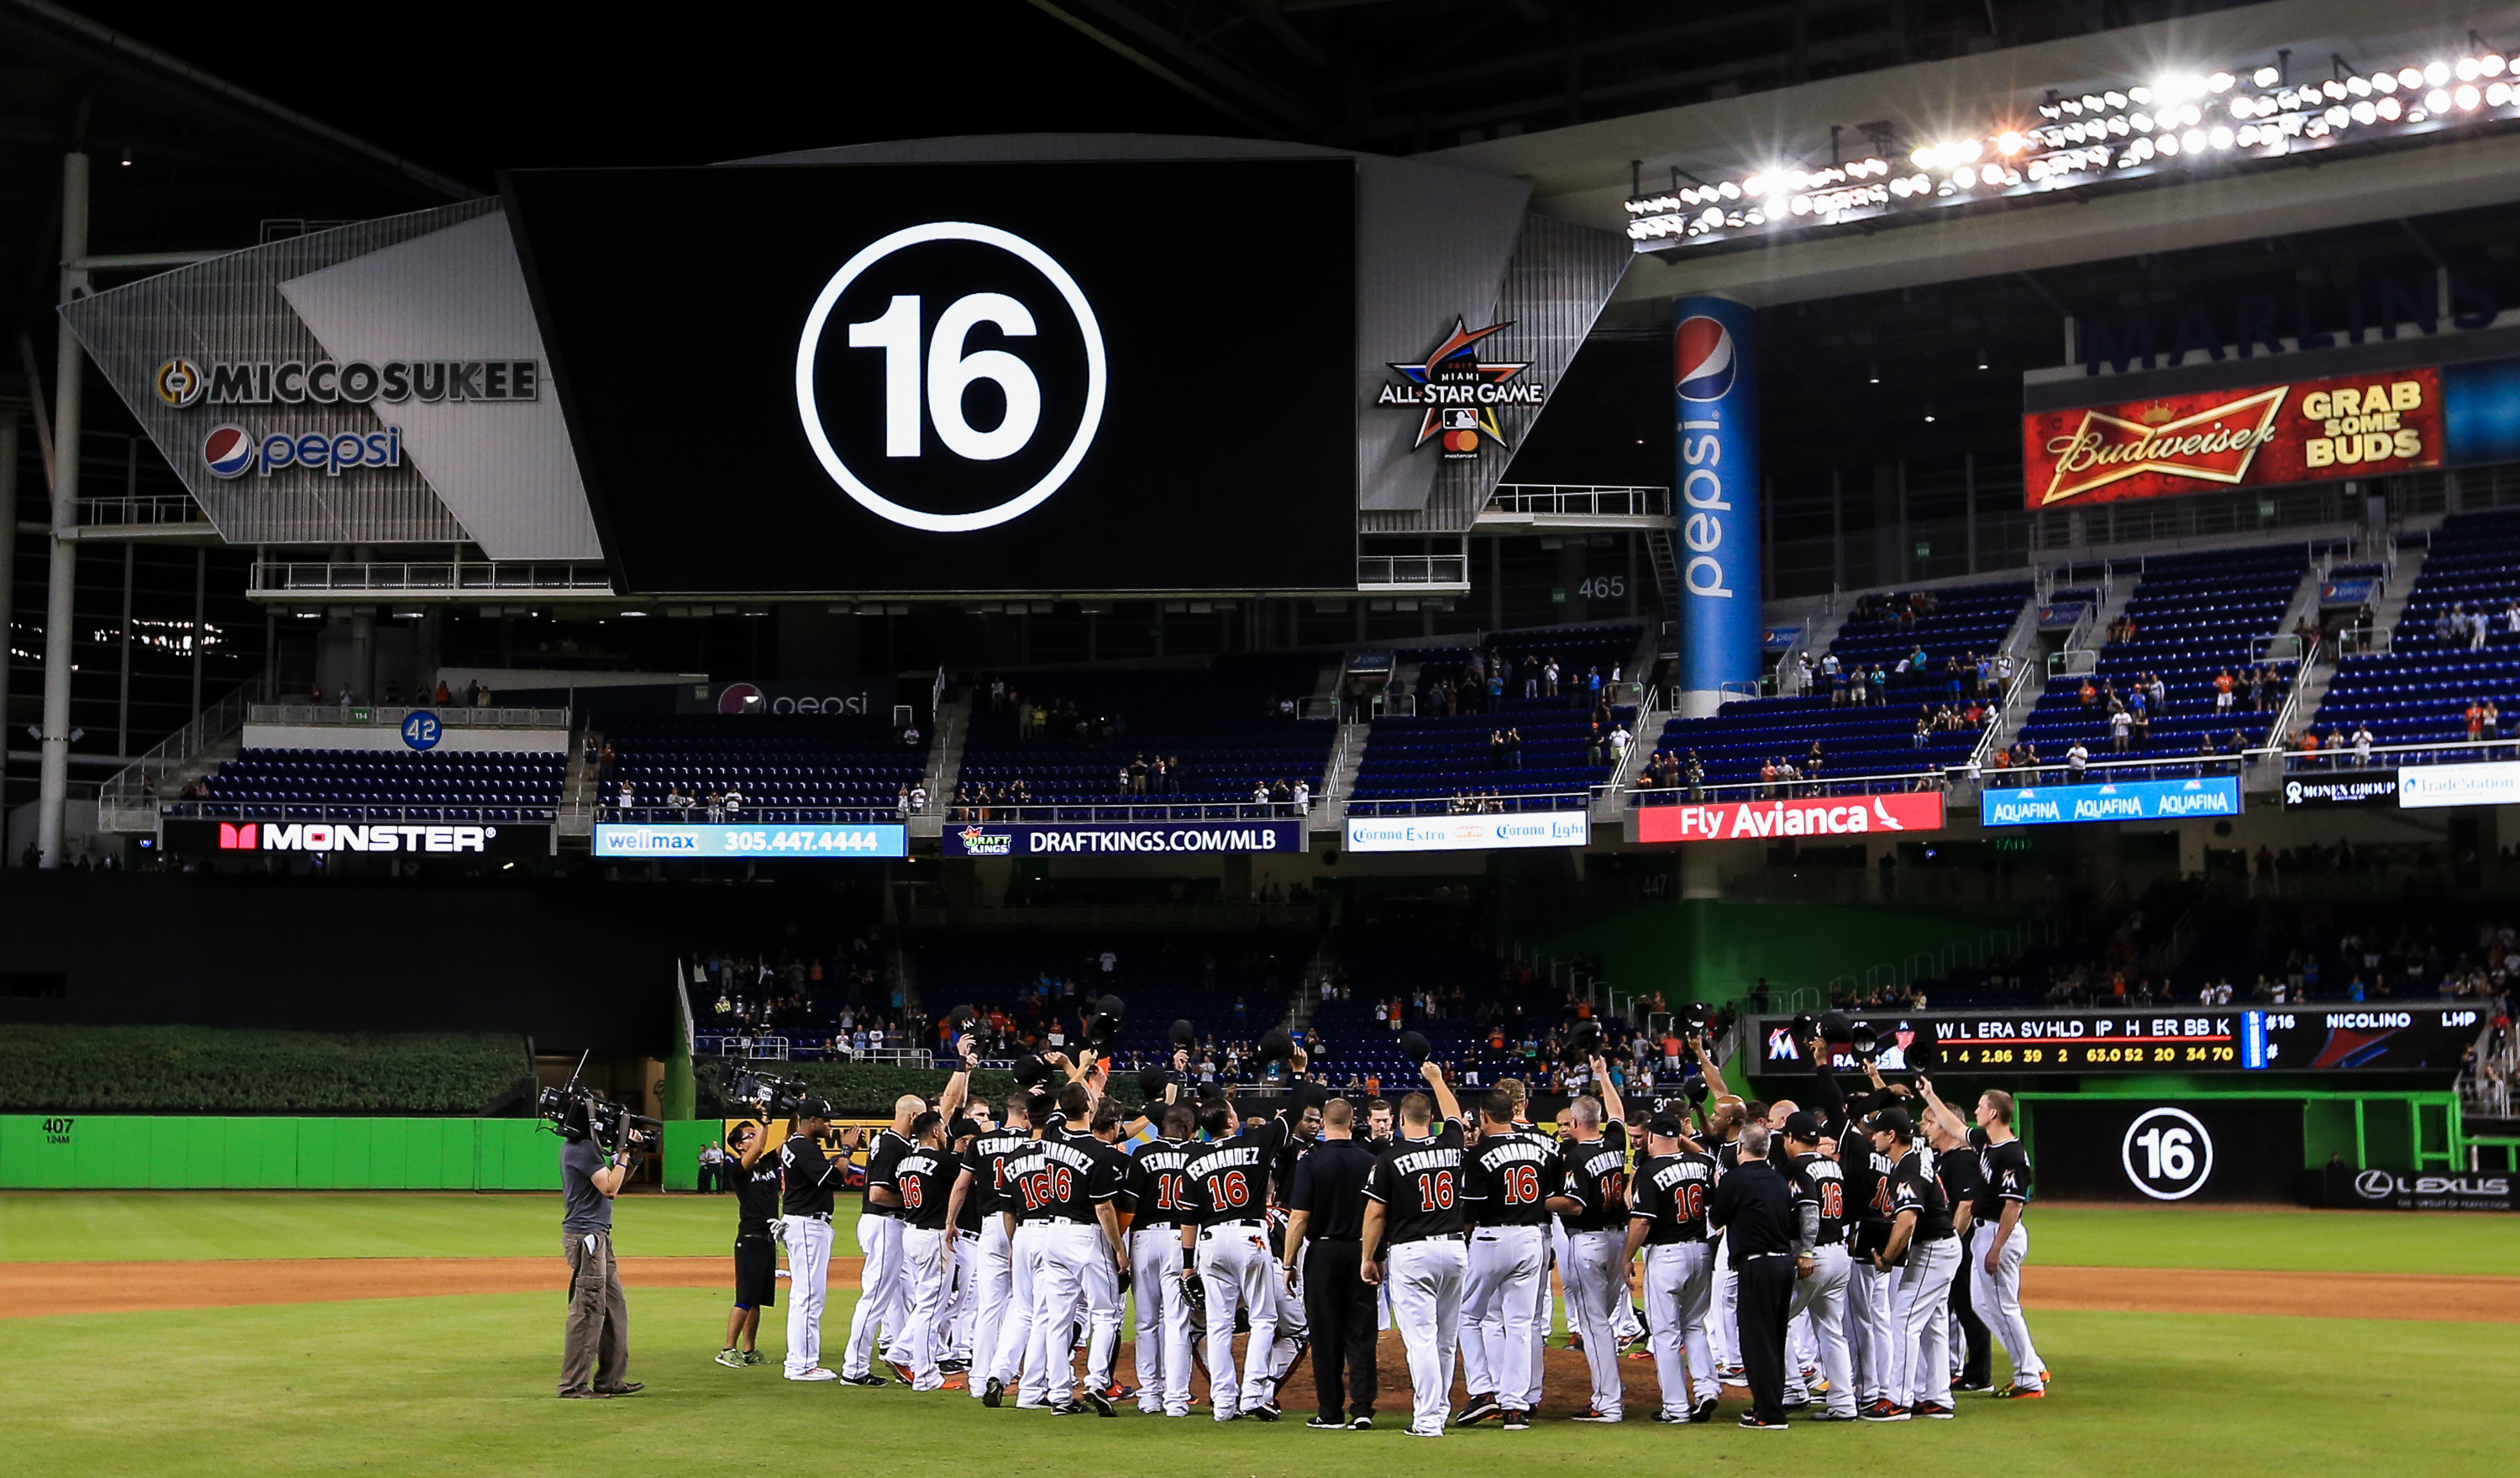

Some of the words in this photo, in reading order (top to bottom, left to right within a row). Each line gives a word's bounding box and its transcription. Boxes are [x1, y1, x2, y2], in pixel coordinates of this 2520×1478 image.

[210, 360, 537, 402] MICCOSUKEE
[848, 292, 1042, 460] 16
[1441, 373, 1479, 381] MIAMI
[1378, 384, 1420, 403] ALL
[1424, 383, 1474, 403] STAR
[1477, 383, 1543, 403] GAME
[2302, 381, 2423, 421] GRAB
[2324, 411, 2401, 437] SOME
[260, 425, 403, 477] pepsi
[2047, 421, 2276, 474] Budweiser
[2306, 429, 2422, 469] BUDS
[1677, 418, 1733, 598] pepsi
[1579, 576, 1625, 599] 465
[406, 718, 437, 742] 42
[2303, 783, 2349, 798] MONEX
[2349, 781, 2397, 795] GROUP
[2418, 776, 2515, 792] TradeStation
[1992, 800, 2061, 823] AQUAFINA
[2074, 796, 2143, 820] AQUAFINA
[2158, 792, 2229, 815] AQUAFINA
[1497, 823, 1545, 839] Corona
[1551, 821, 1584, 839] Light
[1680, 806, 1725, 839] Fly
[1730, 800, 1868, 839] Avianca
[607, 830, 698, 849] wellmax
[723, 831, 878, 852] 305.447.4444
[966, 836, 1010, 846] DRAFT
[1030, 829, 1276, 853] DRAFTKINGS.COM/MLB
[1352, 828, 1403, 844] Corona
[1406, 827, 1445, 841] Extra
[970, 844, 1009, 854] KINGS
[1935, 1023, 1955, 1039] W
[1960, 1023, 1971, 1039] L
[1977, 1022, 2015, 1039] ERA
[2020, 1021, 2044, 1038] SV
[2046, 1021, 2084, 1038] HLD
[2095, 1020, 2113, 1037] IP
[2126, 1020, 2139, 1036] H
[2152, 1019, 2179, 1036] ER
[2184, 1018, 2210, 1035] BB
[2216, 1018, 2231, 1035] K
[2265, 1013, 2296, 1030] #16
[2326, 1012, 2411, 1028] NICOLINO
[2442, 1011, 2477, 1028] LHP
[1940, 1050, 1948, 1063] 1
[1959, 1050, 1970, 1063] 4
[1981, 1049, 2013, 1063] 2.86
[2023, 1049, 2042, 1062] 39
[2057, 1049, 2068, 1062] 2
[2087, 1049, 2121, 1062] 63.0
[2124, 1049, 2144, 1062] 52
[2154, 1049, 2176, 1061] 20
[2187, 1048, 2207, 1061] 34
[2212, 1048, 2234, 1060] 70
[42, 1118, 76, 1134] 407
[1185, 1146, 1260, 1181] FERNANDEZ
[1479, 1143, 1548, 1172] FERNANDEZ
[2136, 1128, 2195, 1180] 16
[899, 1174, 922, 1209] 16
[1019, 1173, 1050, 1211] 16
[1047, 1163, 1073, 1202] 16
[1207, 1170, 1250, 1212] 16
[1418, 1170, 1454, 1212] 16
[1504, 1165, 1540, 1205] 16
[1600, 1171, 1623, 1211] 16
[2397, 1177, 2510, 1195] LEXUS
[1674, 1183, 1704, 1224] 16
[1821, 1181, 1843, 1219] 16
